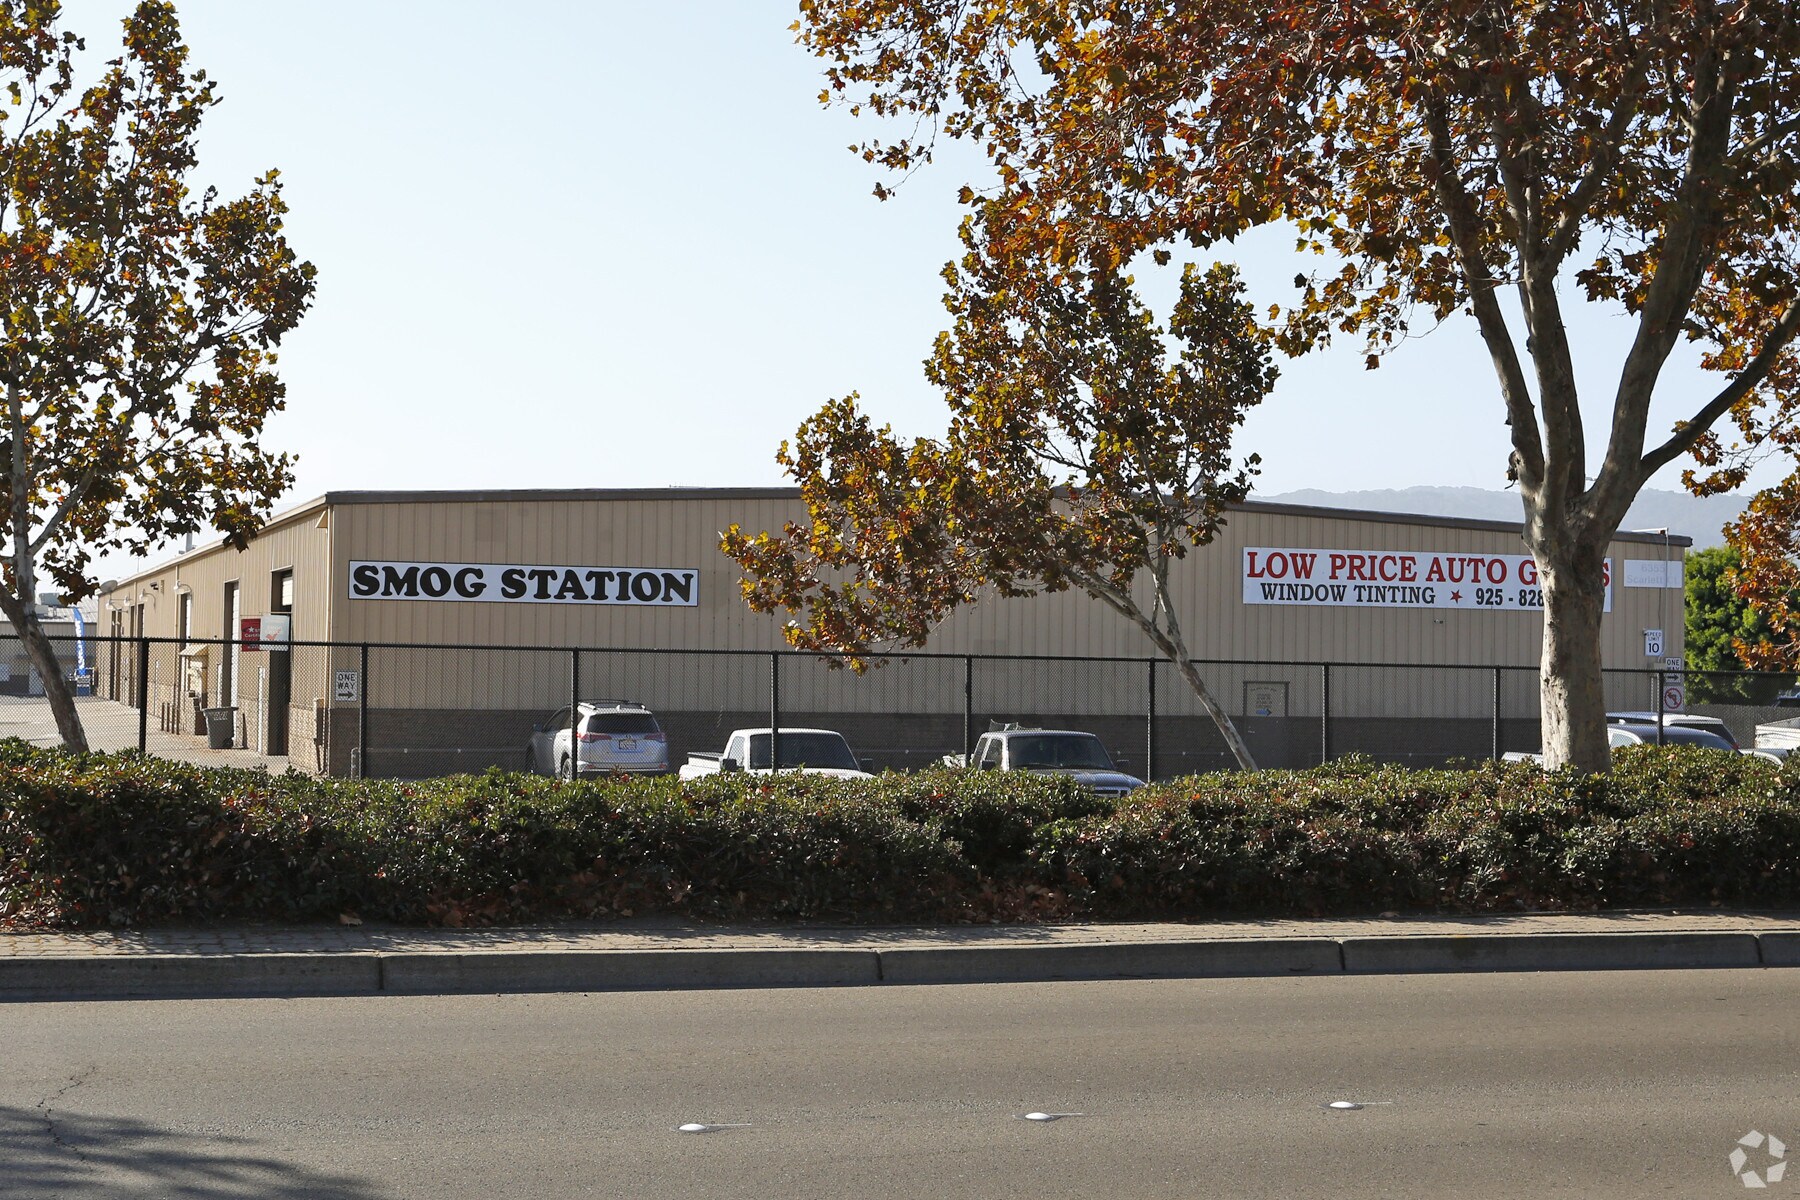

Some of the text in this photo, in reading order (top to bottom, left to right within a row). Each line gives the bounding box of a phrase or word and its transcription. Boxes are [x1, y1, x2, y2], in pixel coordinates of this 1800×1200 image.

[1247, 551, 1317, 579] LOW
[1329, 553, 1417, 582] PRICE
[1426, 556, 1508, 583] AUTO
[1641, 563, 1666, 573] 6355
[353, 565, 694, 603] SMOG STATION
[1260, 582, 1347, 602] WINDOW
[1353, 585, 1436, 605] TINTING
[1475, 588, 1503, 606] 925
[1648, 642, 1660, 653] 10
[338, 673, 356, 682] ONE
[337, 681, 356, 690] WAY
